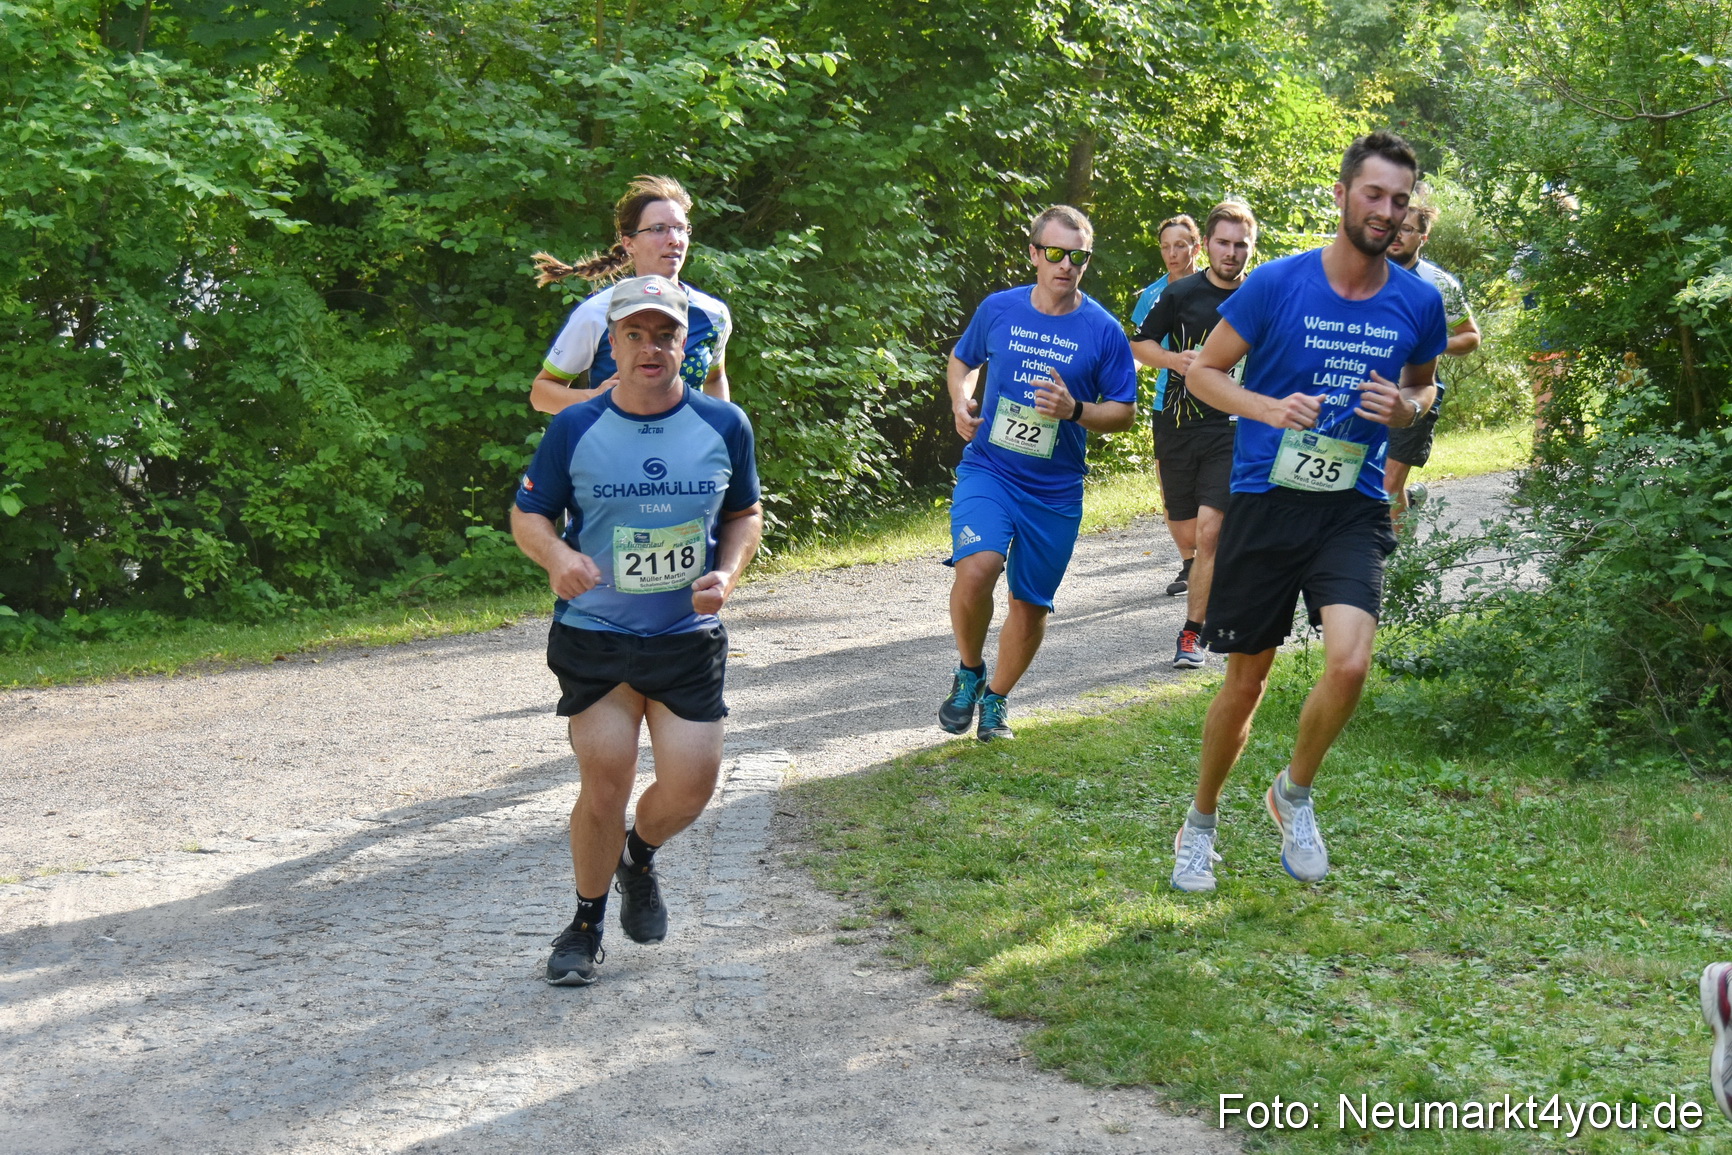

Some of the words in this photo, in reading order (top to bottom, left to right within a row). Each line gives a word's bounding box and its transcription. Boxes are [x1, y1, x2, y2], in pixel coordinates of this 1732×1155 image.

[1010, 325, 1038, 341] Wenn
[1040, 333, 1050, 344] es
[1052, 333, 1079, 352] beim
[1304, 315, 1344, 333] Wenn
[1347, 322, 1361, 335] es
[1364, 322, 1398, 341] beim
[1008, 339, 1074, 365] Hausverkauf
[1304, 335, 1394, 359] Hausverkauf
[1021, 358, 1052, 375] richtig
[1324, 356, 1367, 375] richtig
[1324, 393, 1350, 407] soll!
[1006, 418, 1042, 444] 722
[1294, 452, 1343, 483] 735
[593, 480, 717, 498] SCHABMÜLLER
[1311, 479, 1334, 489] Gabriel
[639, 503, 672, 513] TEAM
[625, 545, 696, 576] 2118
[640, 575, 662, 583] Müller
[664, 571, 686, 581] Martin
